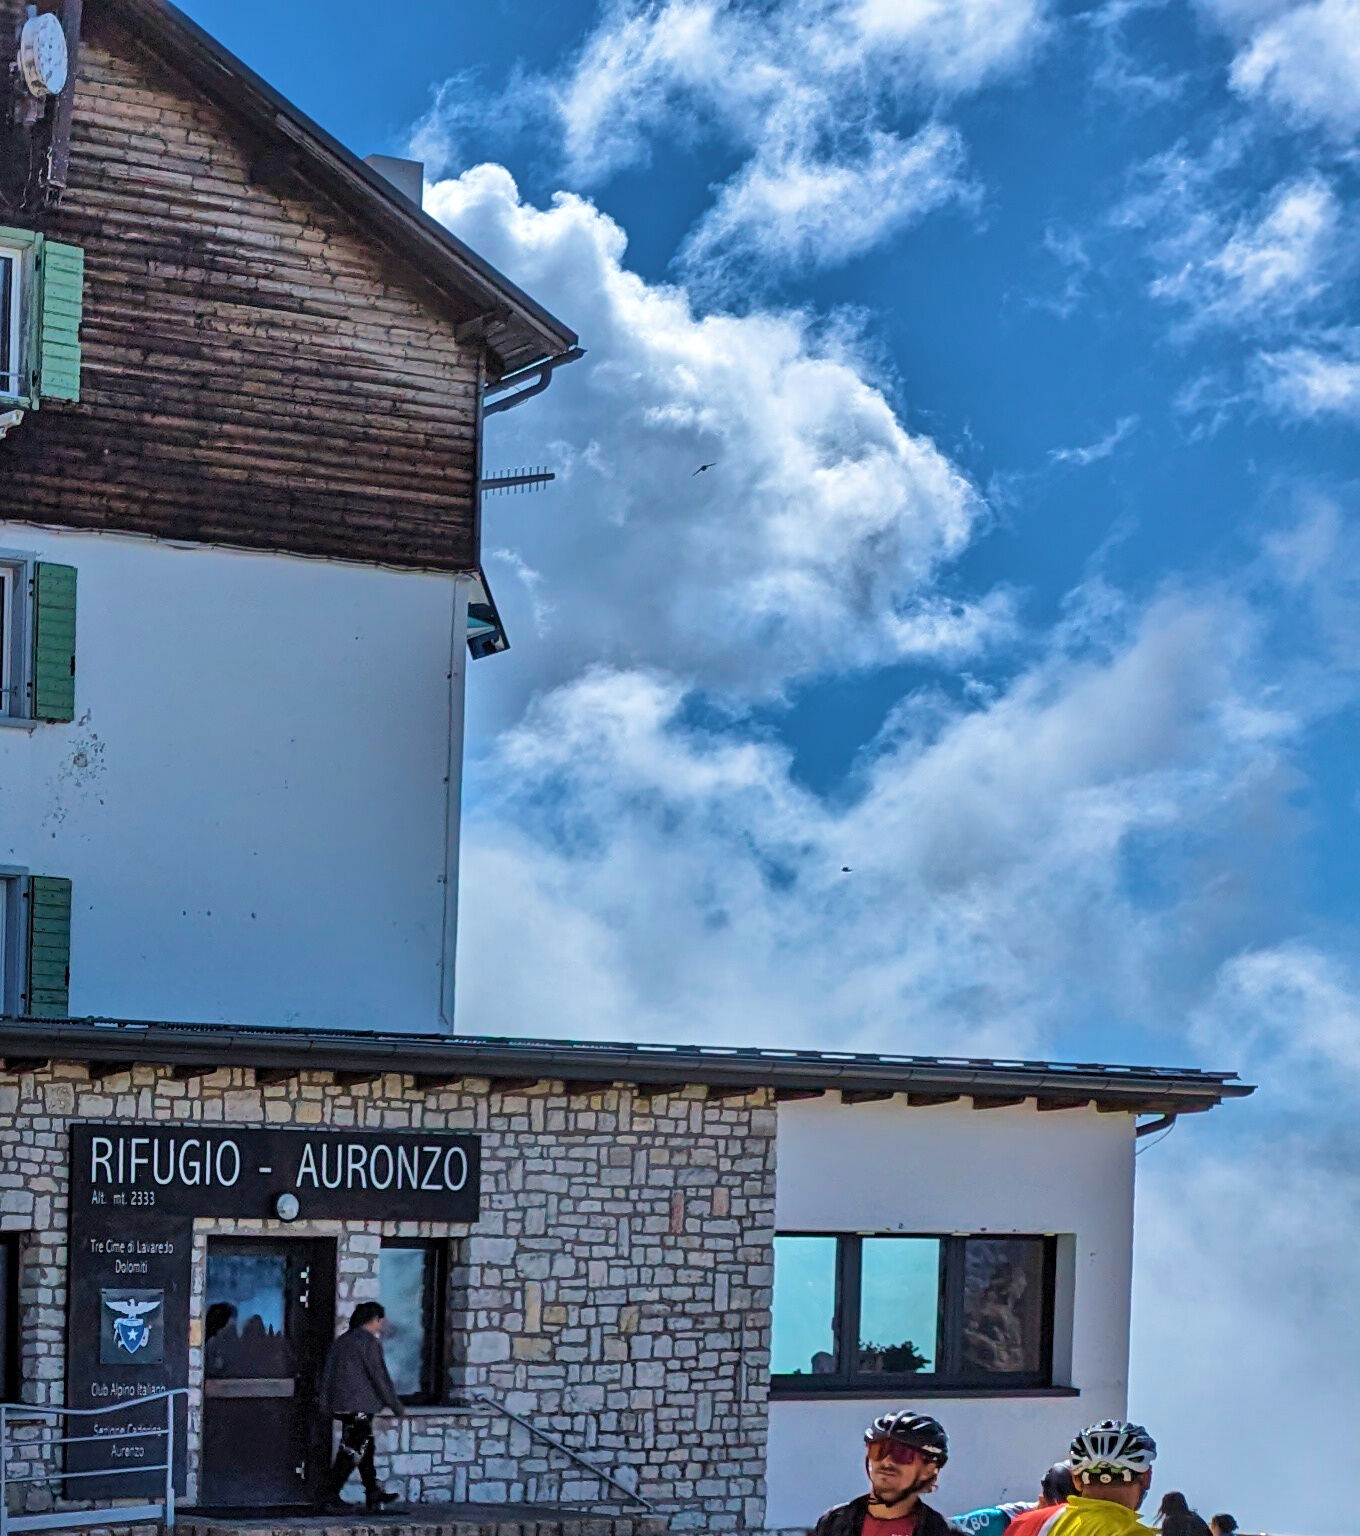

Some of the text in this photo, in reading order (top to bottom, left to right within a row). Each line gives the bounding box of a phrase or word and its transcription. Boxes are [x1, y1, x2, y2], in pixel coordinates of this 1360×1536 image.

[91, 1137, 241, 1187] RIFUGIO
[296, 1143, 468, 1191] AURONZO
[130, 1191, 155, 1206] 2333
[91, 1239, 174, 1254] Tre Cime di Lavaredo
[115, 1259, 148, 1274] Dolomiti
[91, 1382, 166, 1398] Club Alpino Italiano
[111, 1444, 145, 1458] Auronzo
